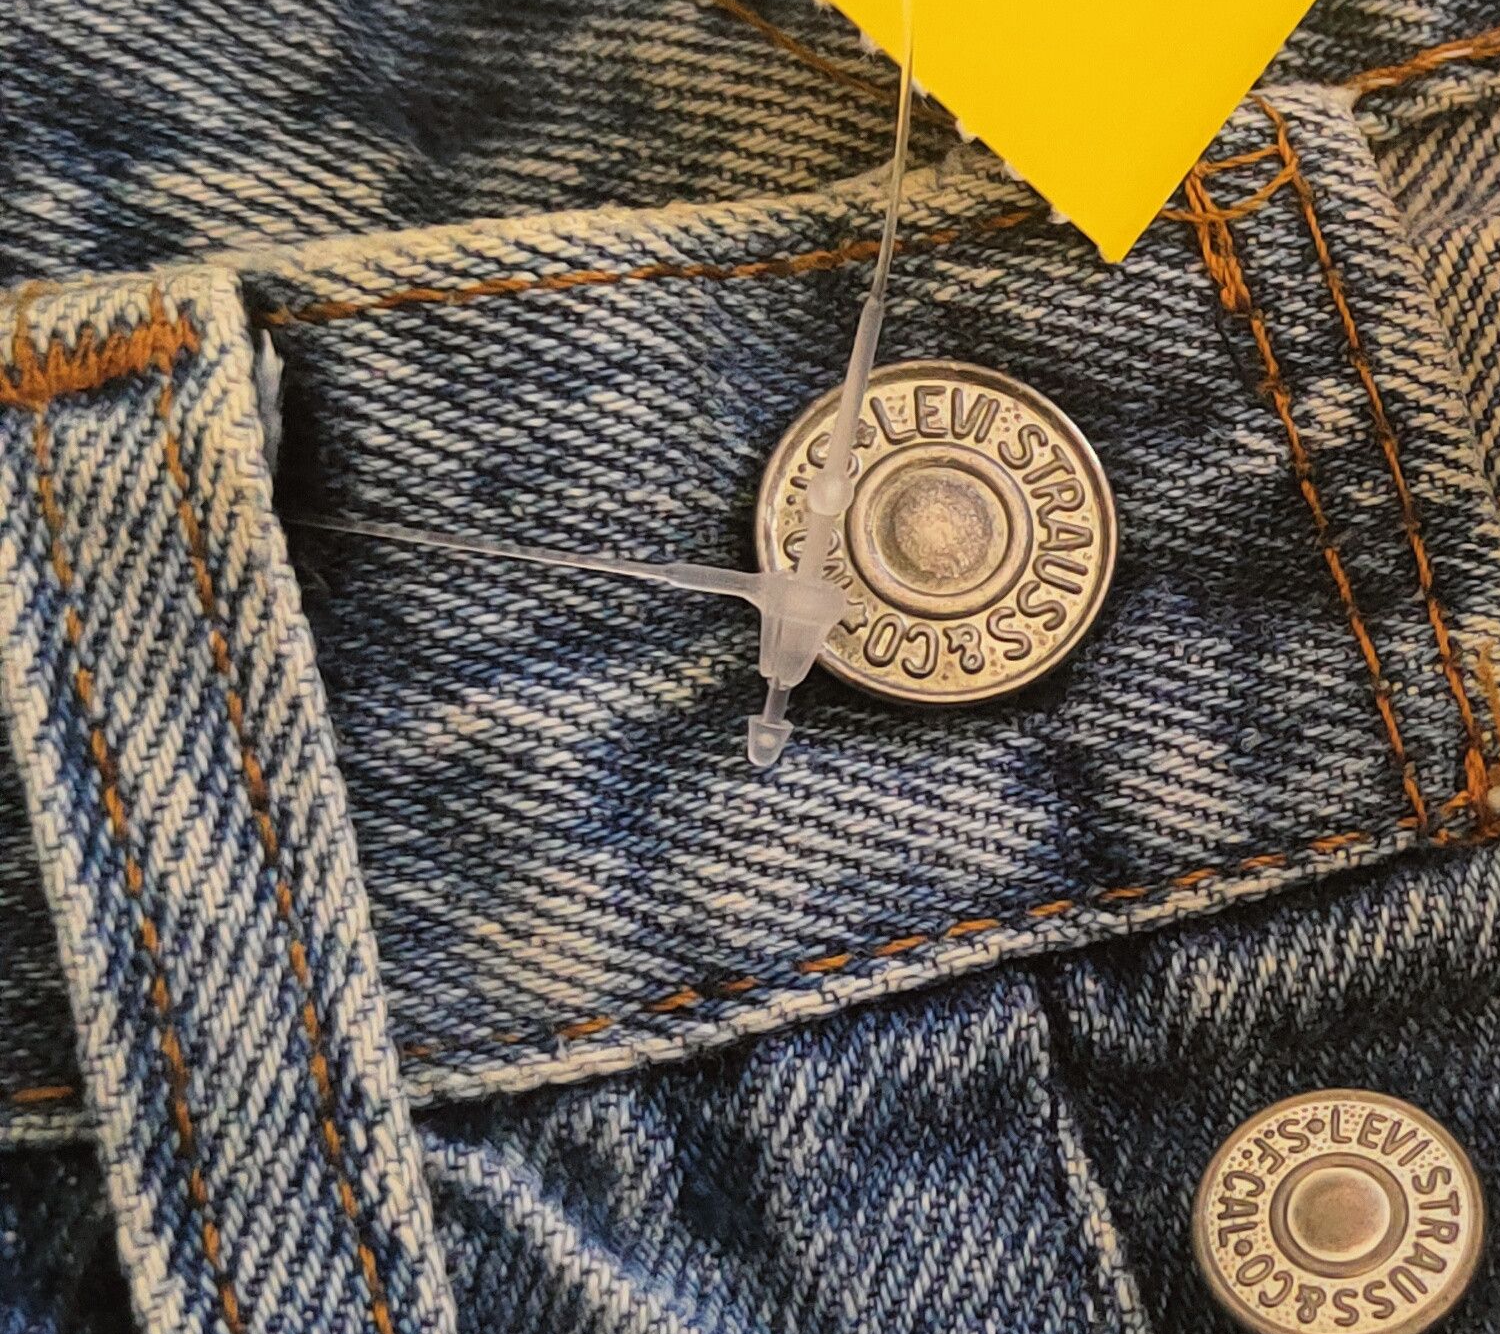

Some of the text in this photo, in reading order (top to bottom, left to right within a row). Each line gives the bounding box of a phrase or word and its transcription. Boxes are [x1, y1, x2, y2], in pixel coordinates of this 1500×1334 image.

[869, 384, 1001, 446] LEVI
[986, 423, 1094, 662] STRAUSS
[1329, 1104, 1434, 1168] LEVI
[1331, 1165, 1461, 1328] STRAUSS
